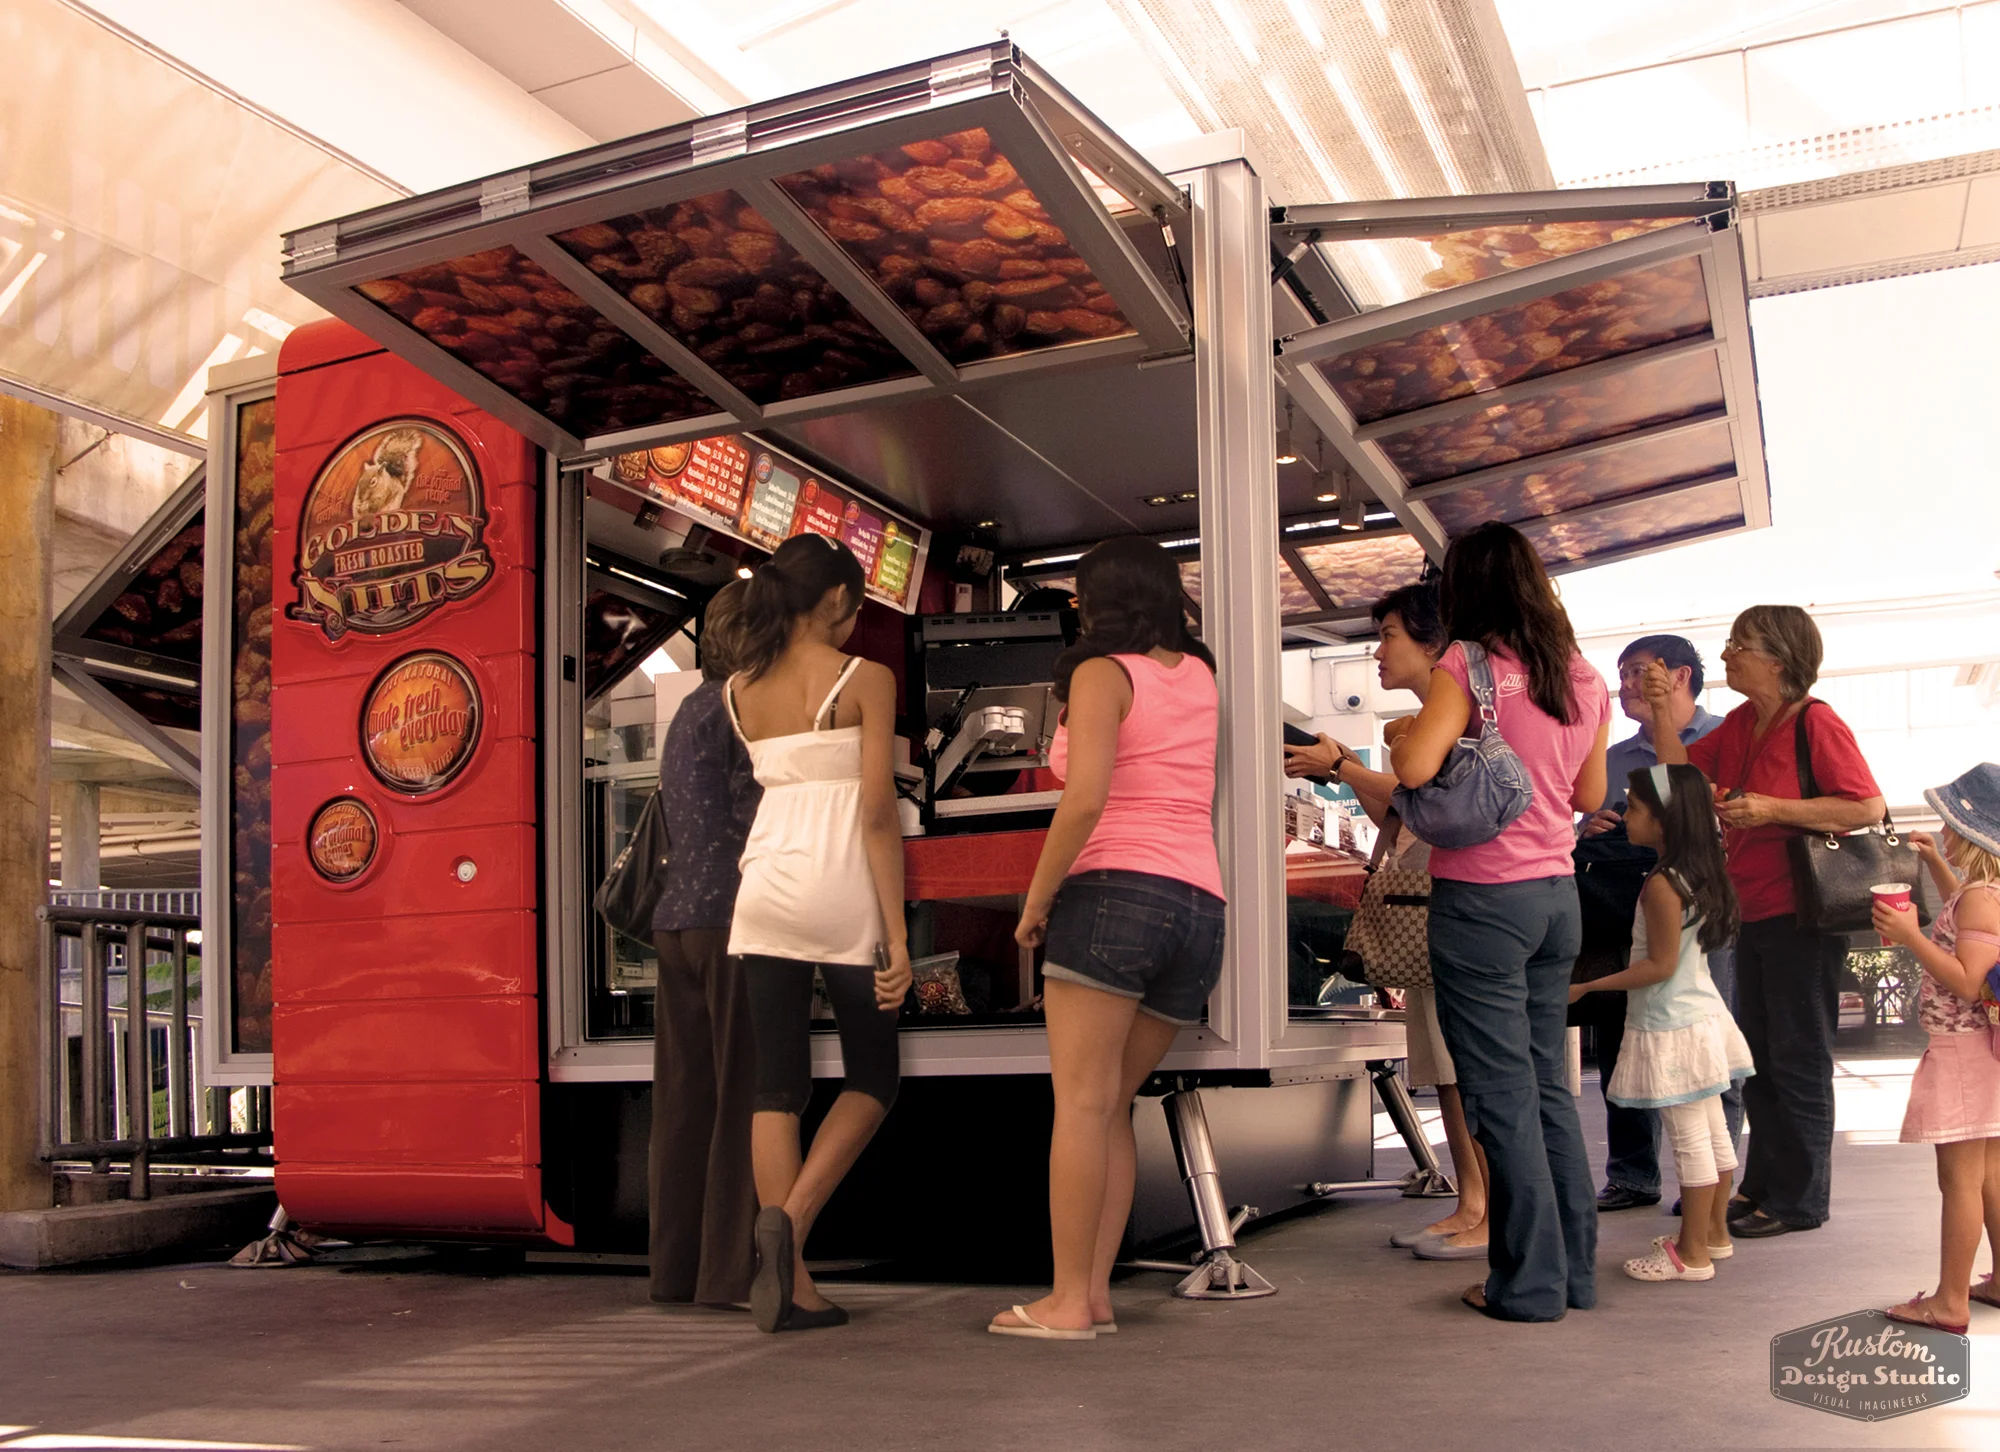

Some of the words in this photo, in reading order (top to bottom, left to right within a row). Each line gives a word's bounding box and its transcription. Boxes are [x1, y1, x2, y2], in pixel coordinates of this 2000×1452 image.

[302, 510, 484, 570] GOLDEN
[335, 551, 365, 574] FRESH
[372, 542, 424, 565] ROASTED
[293, 549, 491, 634] NUTS
[404, 664, 453, 687] NATURAL
[370, 703, 399, 734] made
[403, 682, 440, 724] fresh
[400, 705, 468, 750] everyday
